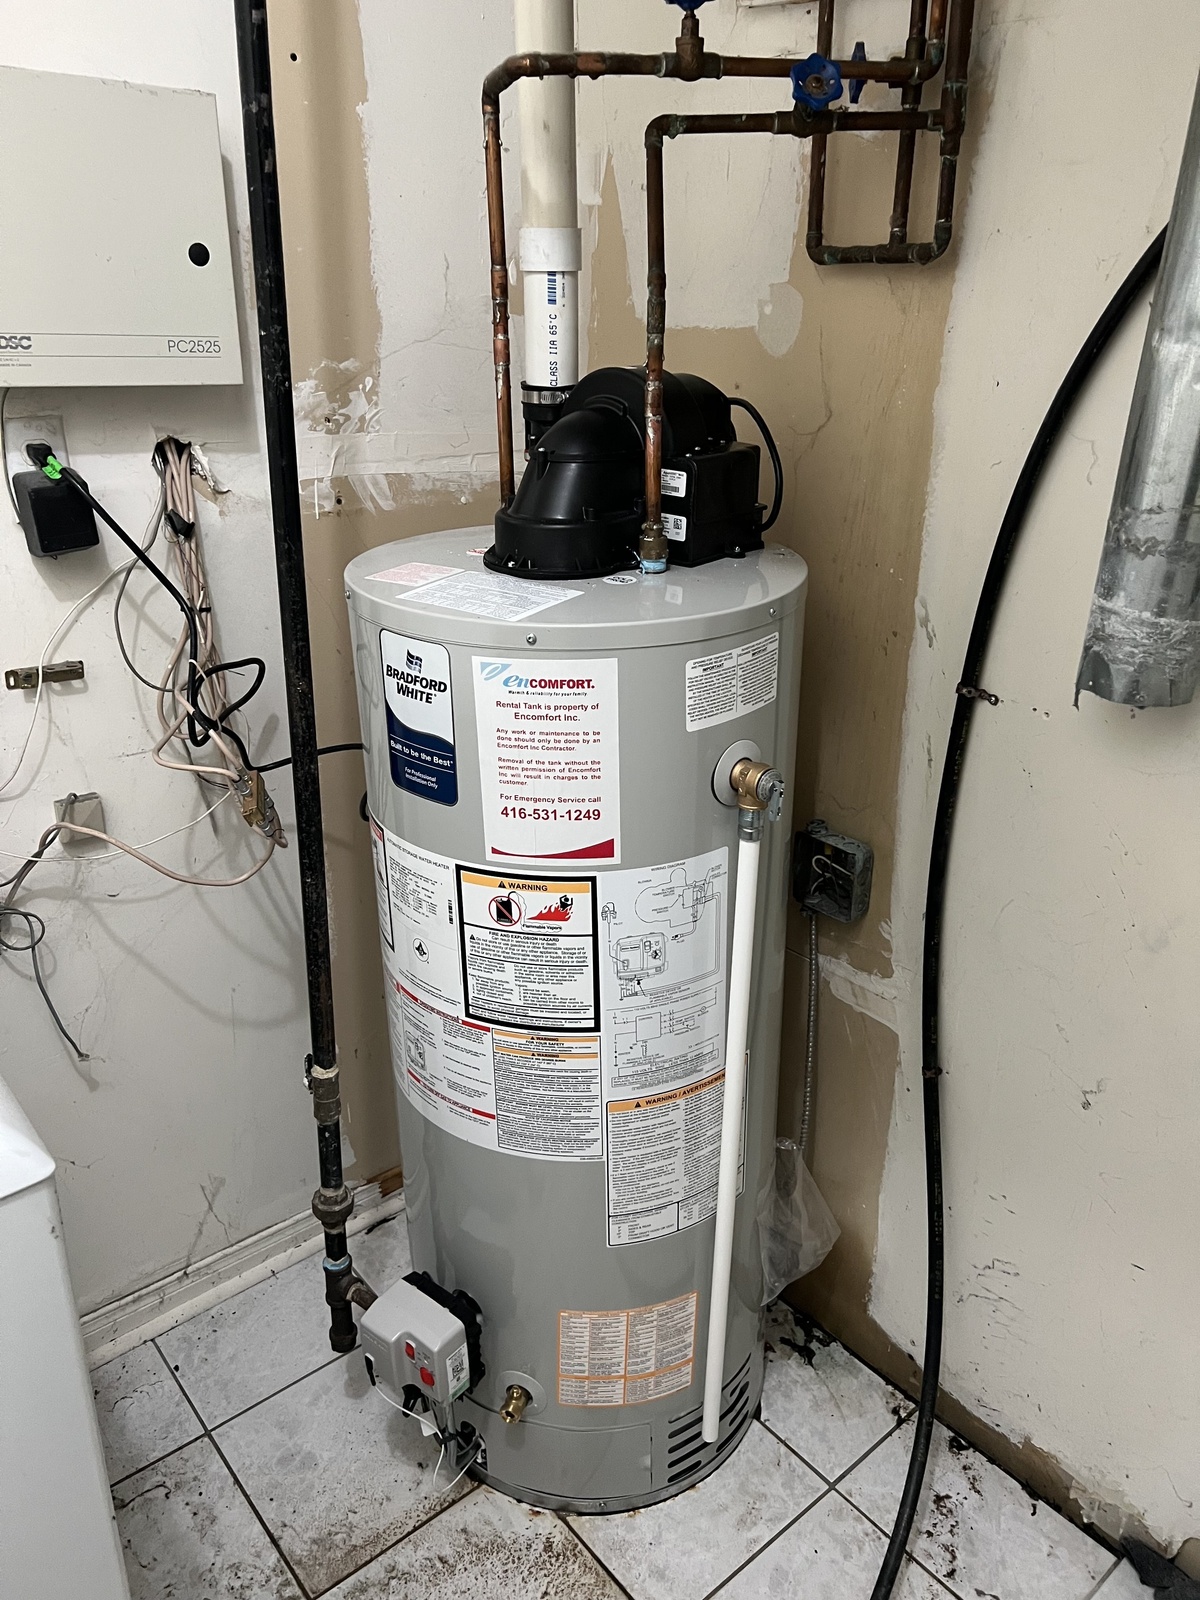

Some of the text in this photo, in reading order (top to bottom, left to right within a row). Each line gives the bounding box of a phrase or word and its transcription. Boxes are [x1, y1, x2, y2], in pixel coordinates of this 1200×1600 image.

[167, 339, 222, 354] PC2525
[549, 340, 558, 355] IIA
[550, 360, 558, 386] CLASS
[386, 664, 448, 693] BRADFORD
[496, 700, 520, 709] Rental
[523, 702, 542, 710] Tank
[544, 702, 551, 710] is
[554, 704, 588, 712] property
[514, 712, 561, 721] Encomfort
[390, 740, 450, 766] Built to be the Best
[497, 742, 528, 750] Encomfort
[514, 794, 555, 804] Emergency
[500, 806, 601, 821] 416-531-1249
[508, 882, 548, 892] WARNING
[645, 1093, 677, 1105] WARNING
[682, 1071, 725, 1096] AVERTISSEMEN
